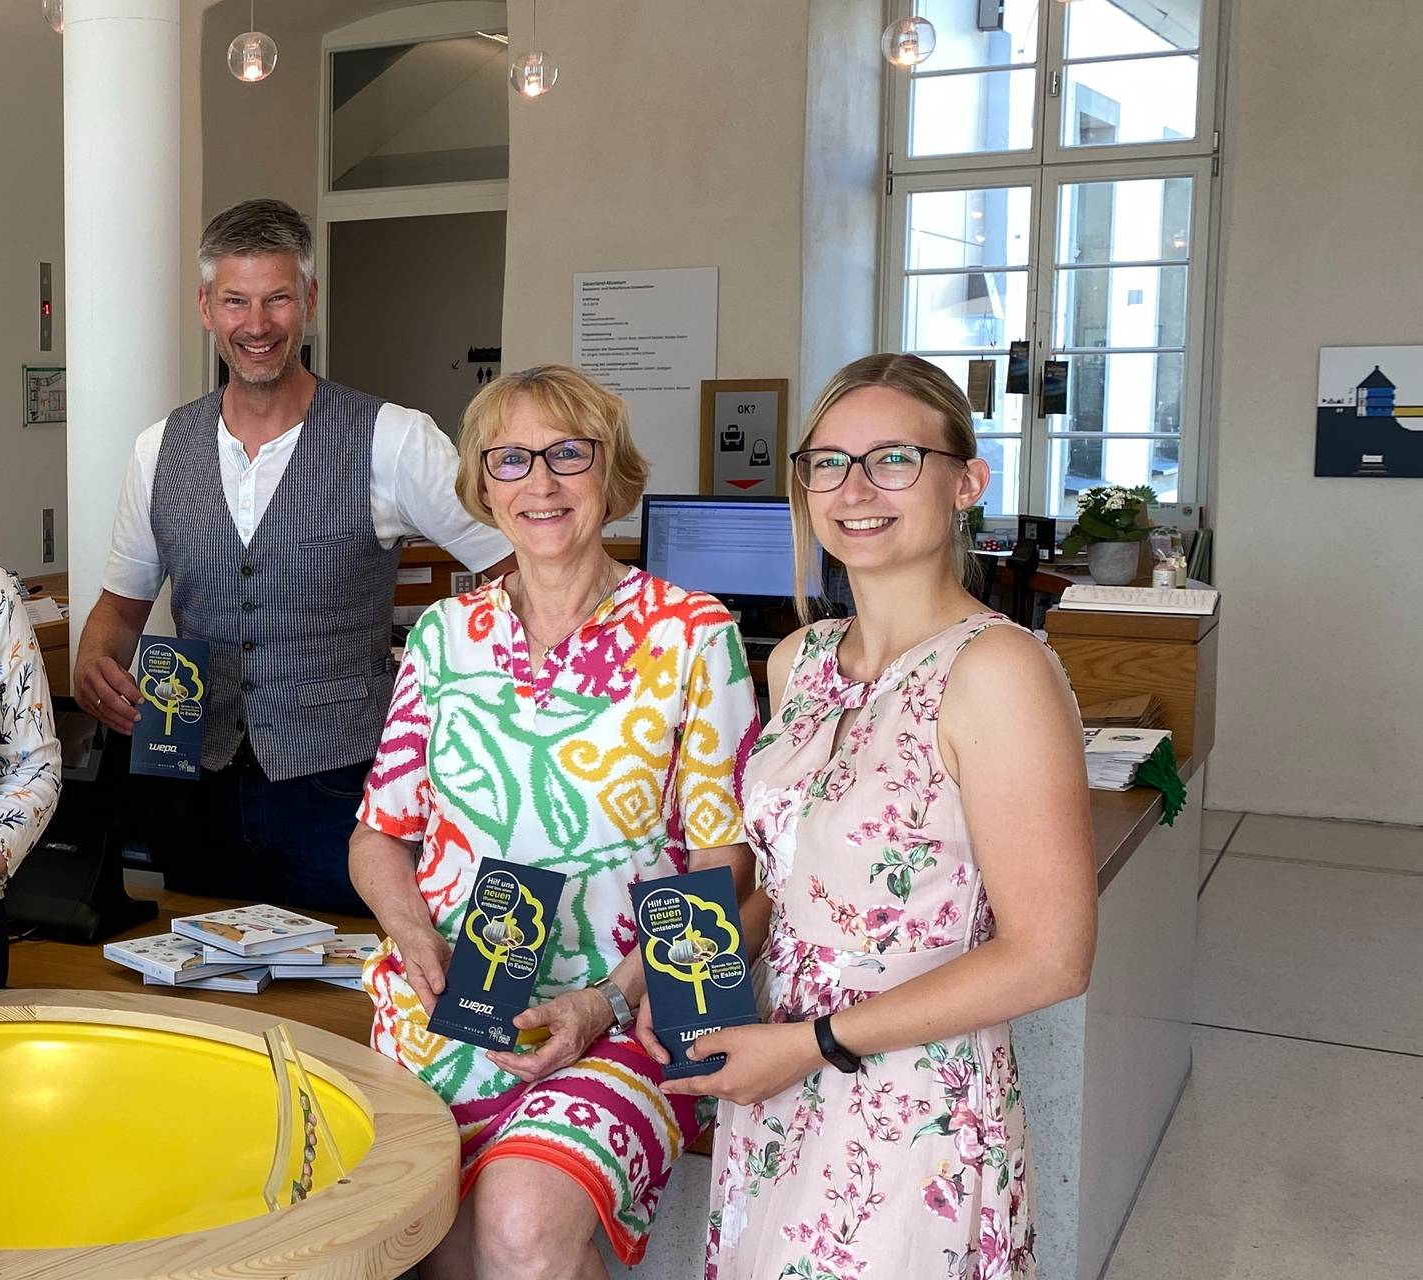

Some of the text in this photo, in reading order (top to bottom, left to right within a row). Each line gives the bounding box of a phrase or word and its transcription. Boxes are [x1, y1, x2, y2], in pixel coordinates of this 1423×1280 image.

[737, 404, 756, 414] OK?
[148, 743, 177, 753] wepa
[487, 877, 515, 889] Hilf uns
[483, 889, 511, 901] neuen
[647, 897, 680, 909] Hilf uns
[649, 909, 682, 921] neuen
[652, 923, 684, 933] entstehen
[720, 970, 743, 979] Eslohe
[459, 998, 494, 1015] wepa
